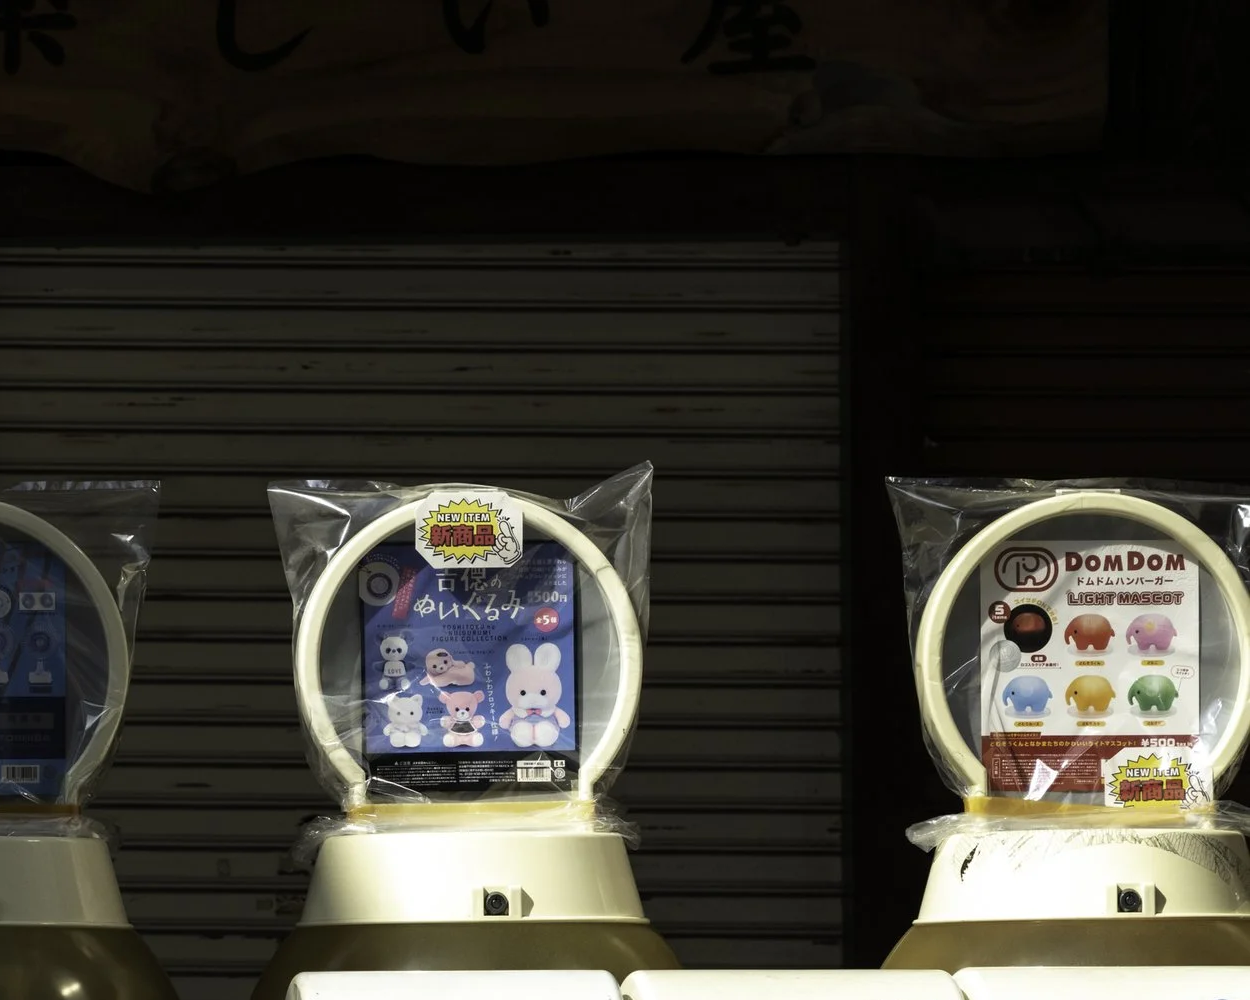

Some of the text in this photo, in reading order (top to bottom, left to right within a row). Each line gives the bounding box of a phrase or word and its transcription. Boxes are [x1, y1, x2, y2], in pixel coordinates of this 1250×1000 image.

[437, 513, 490, 522] NEW ITEM
[430, 525, 496, 547] 新商品
[1076, 576, 1174, 586] ドムドムハンバーガー
[1067, 592, 1184, 605] LIGHT MASCOT
[413, 590, 525, 622] ぬいぐるみ
[994, 604, 1005, 615] 5
[1141, 738, 1176, 747] ¥500
[1125, 767, 1180, 778] NEW ITEM
[1119, 779, 1185, 802] 新商品
